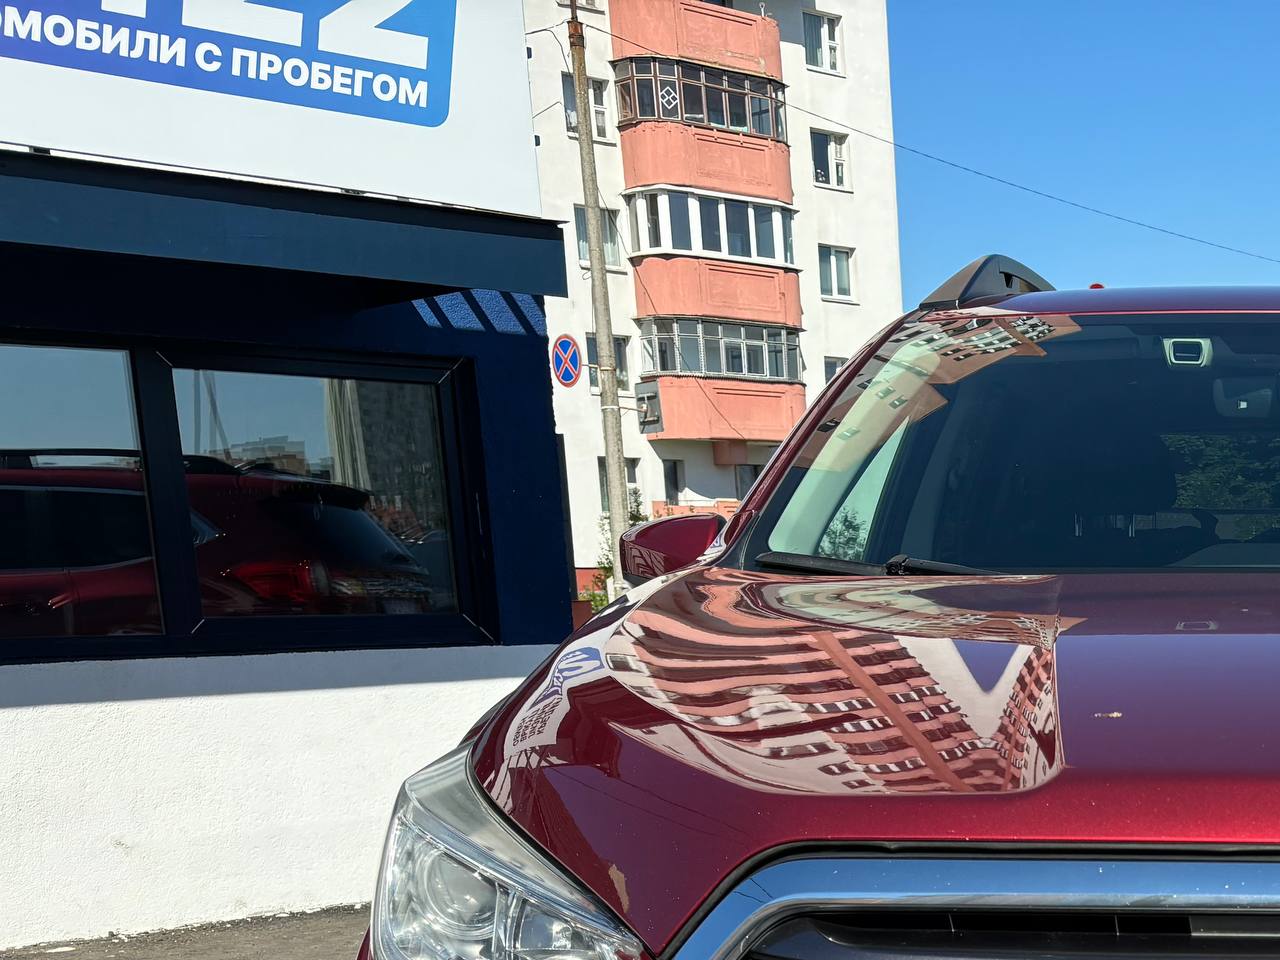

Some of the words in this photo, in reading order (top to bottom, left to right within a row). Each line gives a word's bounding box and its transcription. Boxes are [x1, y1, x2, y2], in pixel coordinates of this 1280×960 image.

[0, 6, 186, 67] МОБИЛИ
[195, 42, 222, 72] С
[231, 47, 428, 108] ПРОБЕГОМ
